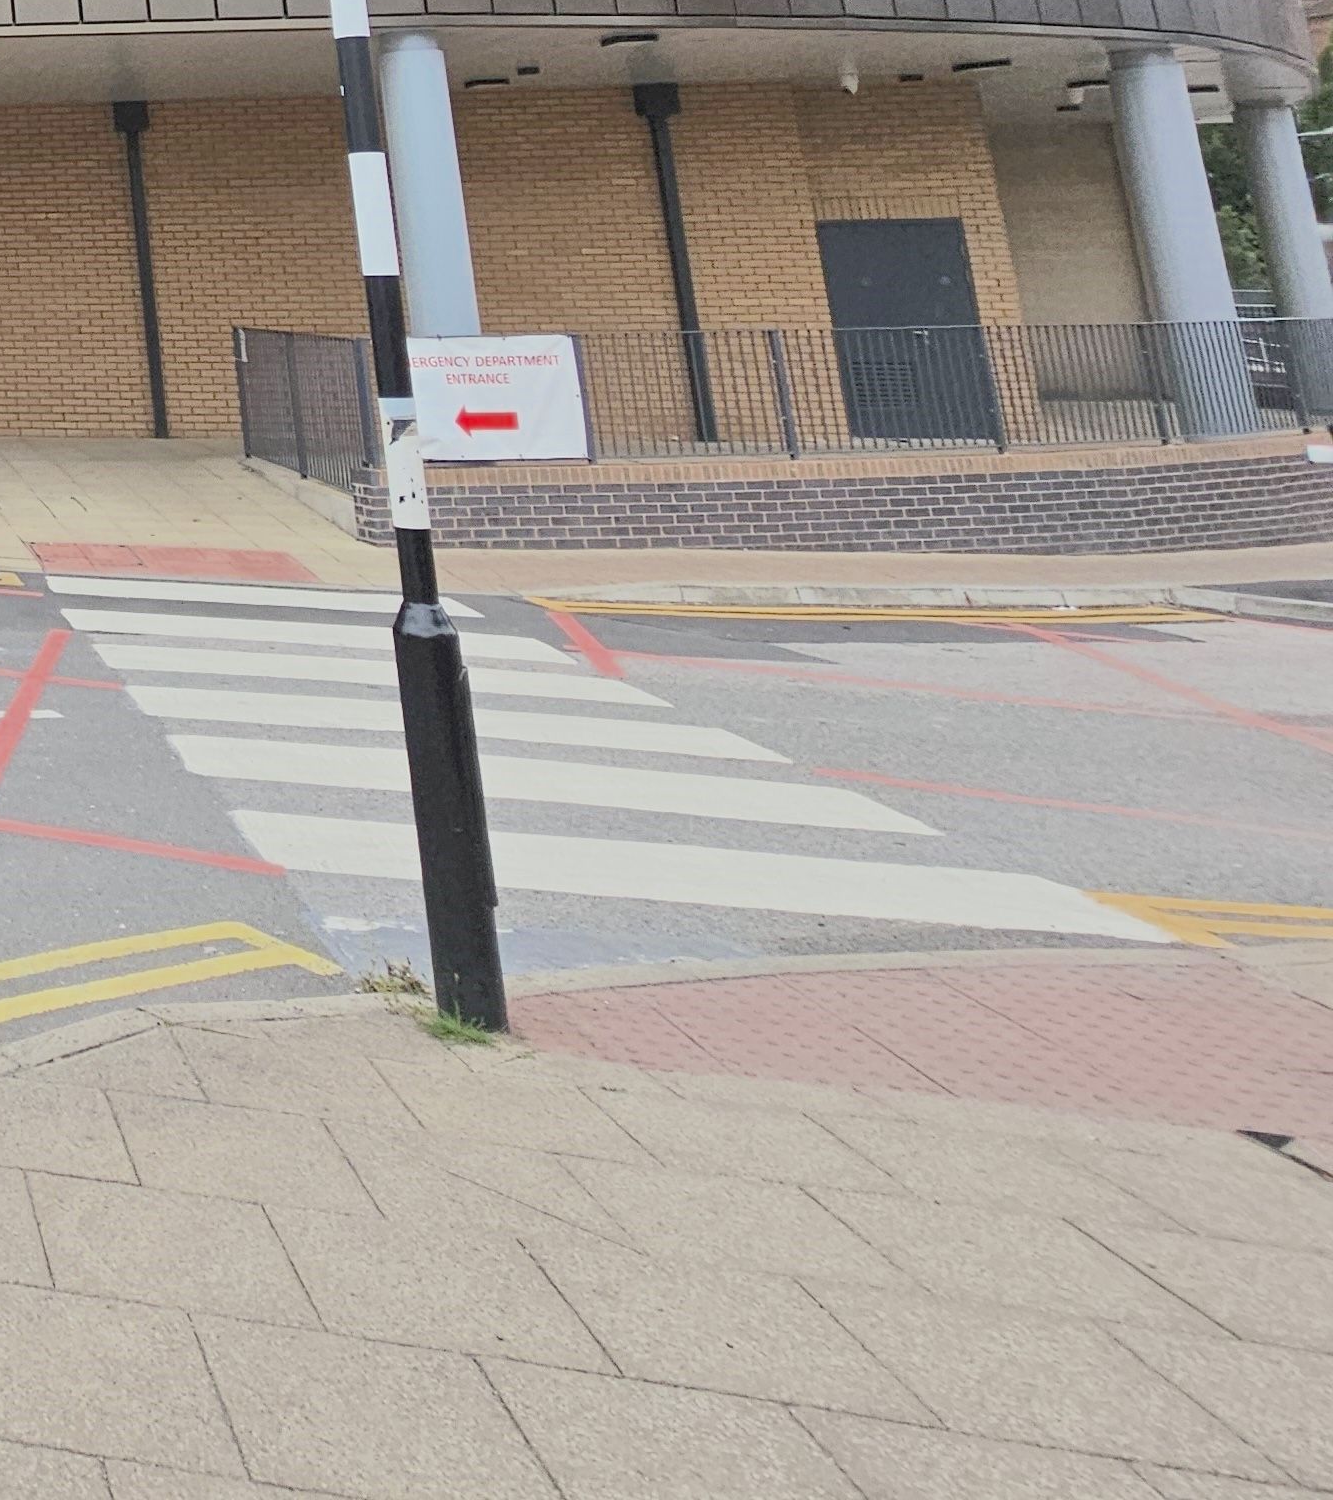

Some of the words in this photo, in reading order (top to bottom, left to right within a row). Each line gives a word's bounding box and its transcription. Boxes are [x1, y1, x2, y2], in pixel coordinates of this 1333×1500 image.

[410, 356, 470, 368] ERGENCY
[476, 355, 559, 367] DEPARTMENT
[446, 373, 510, 385] ENTRANCE
